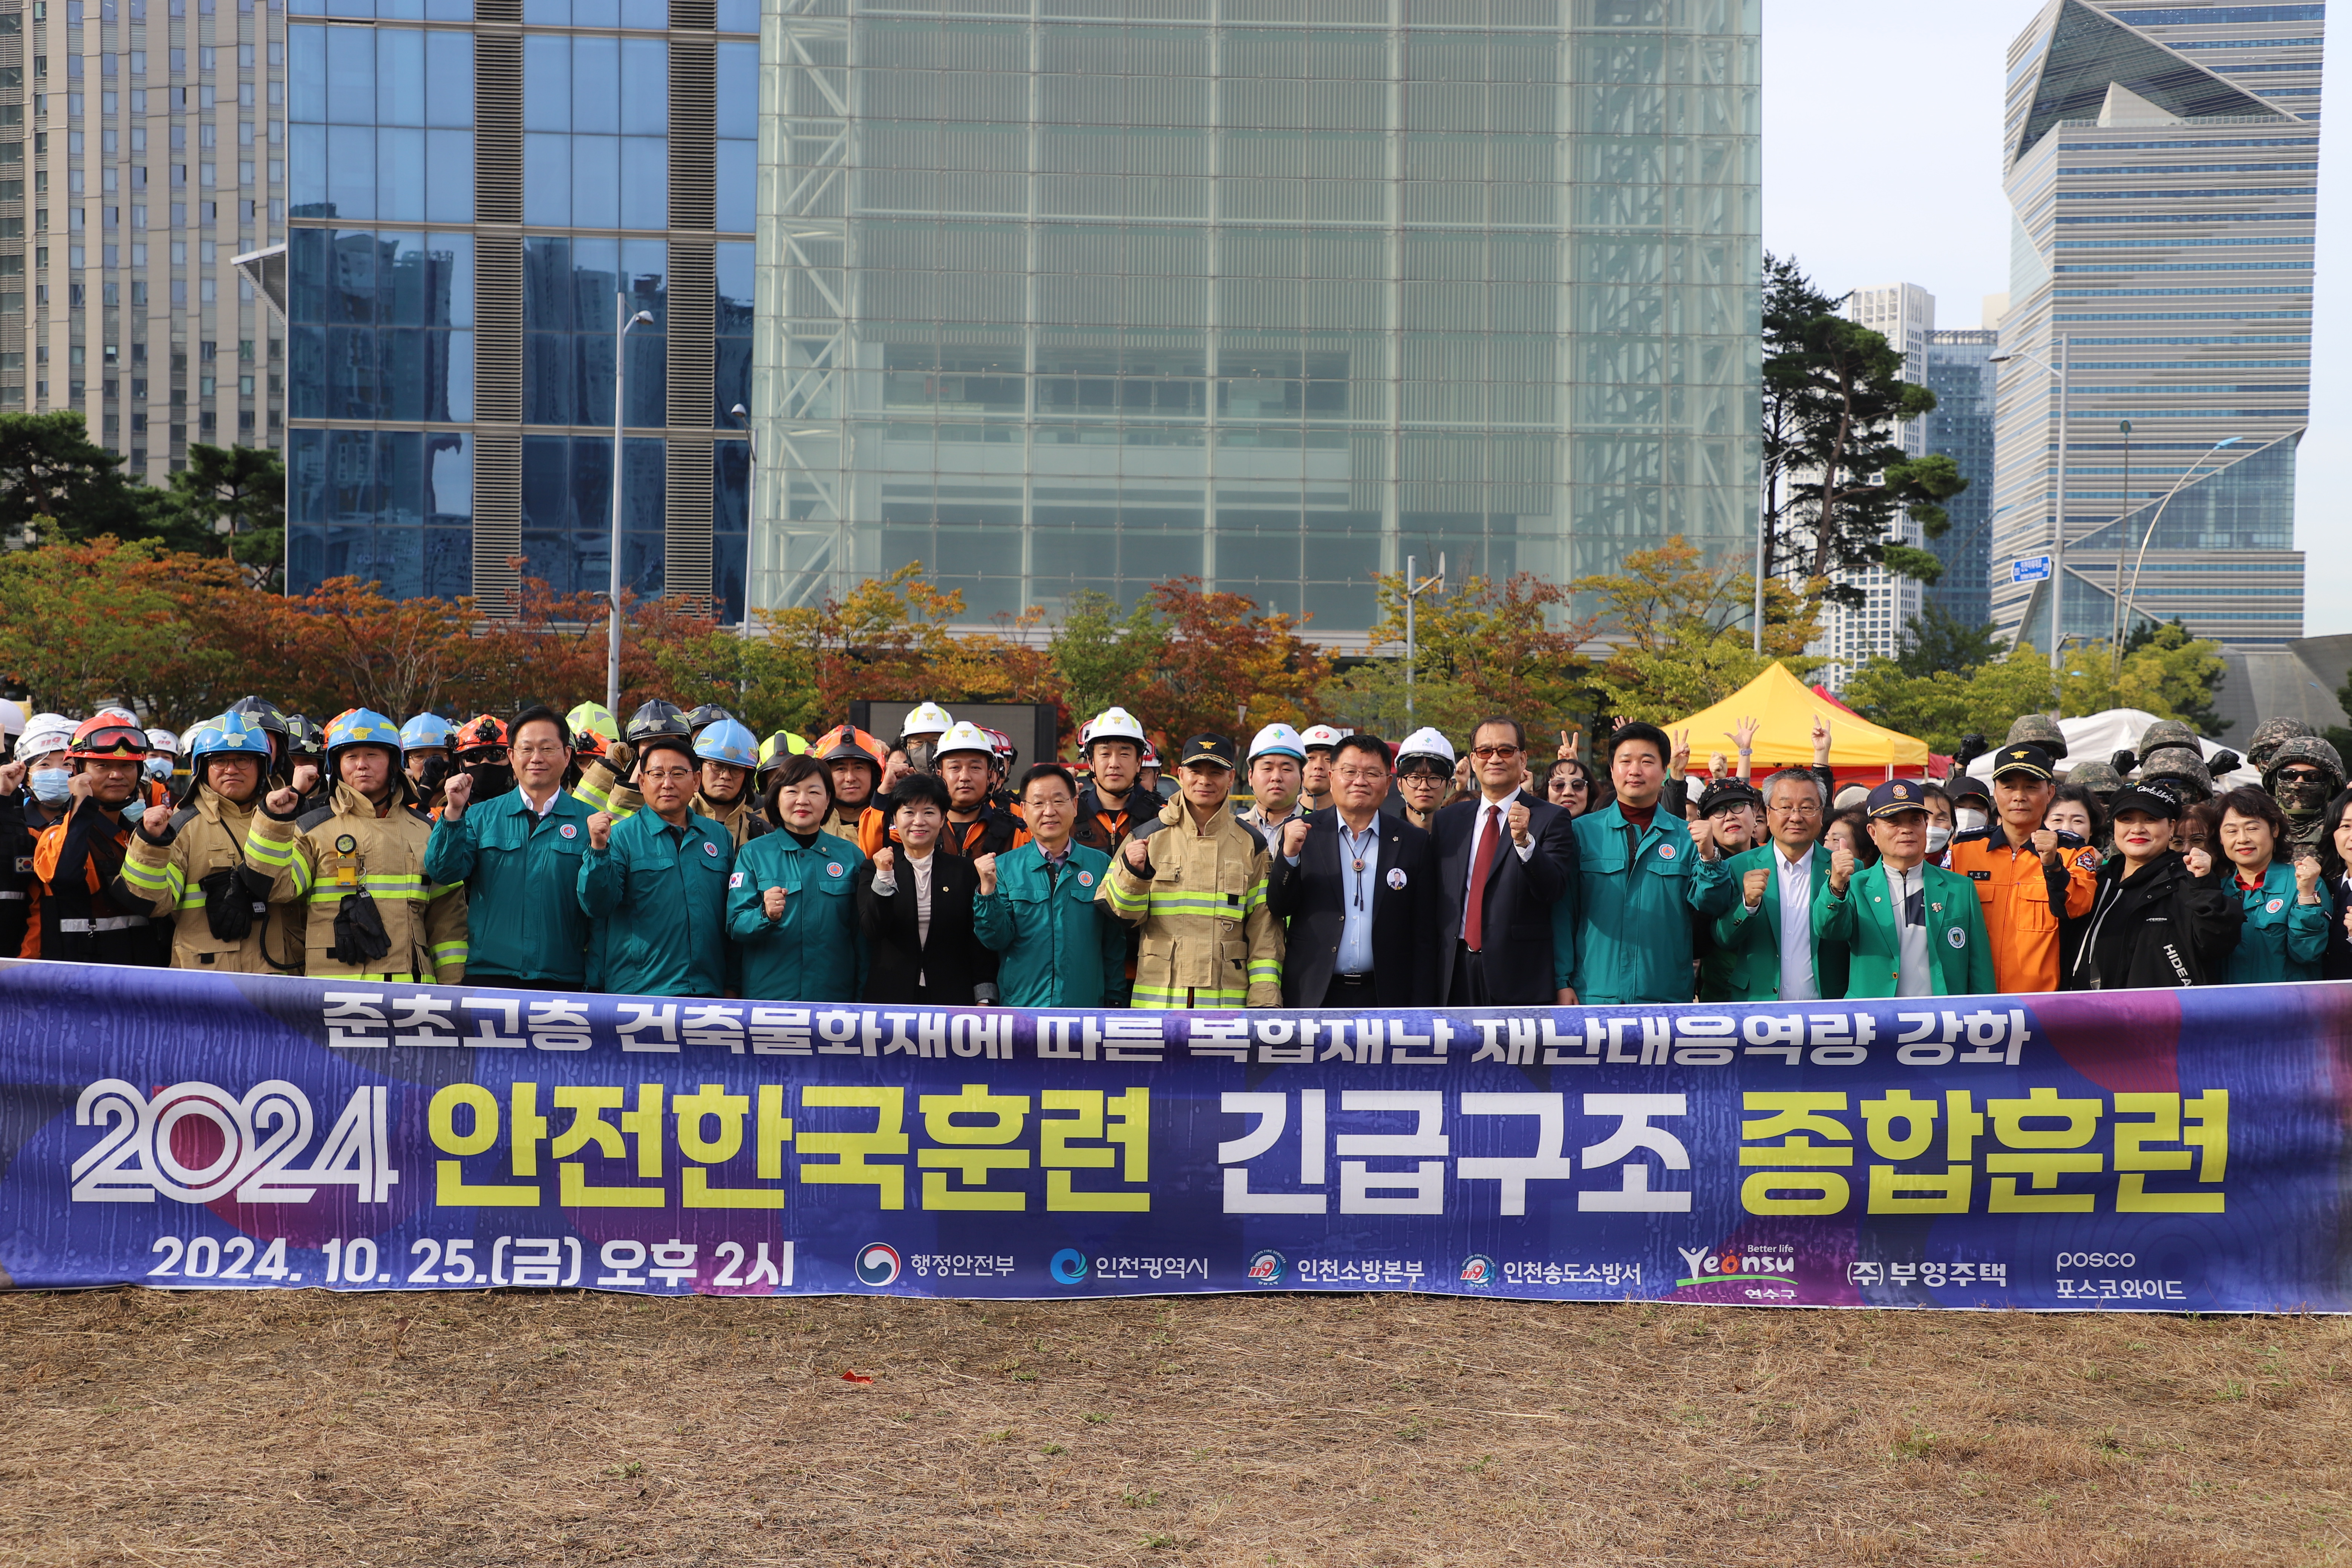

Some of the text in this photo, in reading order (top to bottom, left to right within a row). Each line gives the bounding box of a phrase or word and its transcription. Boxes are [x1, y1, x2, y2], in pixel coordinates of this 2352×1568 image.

[40, 737, 62, 747] 119
[323, 992, 2031, 1065] 준초고층 건축물화재에 따른 복합재난 재난대응역량 강화
[72, 1078, 2229, 1216] 2024 안전한국훈련 긴급구조 종합훈련
[1250, 1250, 1263, 1263] INCHEON
[1273, 1250, 1287, 1264] SERVICES
[1747, 1244, 1794, 1253] Better life
[147, 1236, 794, 1287] 2024. 10. 25.(금) 오후 2시
[911, 1254, 1015, 1277] 행정안전부
[1096, 1257, 1208, 1280] 인천광역시
[1248, 1260, 1275, 1277] 119
[1298, 1259, 1425, 1283] 인천소방본부
[1461, 1255, 1474, 1267] INCHEON
[1483, 1254, 1496, 1267] SERVICES
[1678, 1246, 1794, 1281] Yeonsu
[2056, 1252, 2136, 1272] posco
[1460, 1264, 1485, 1280] 119
[1504, 1262, 1641, 1286] 인천송도소방서
[1744, 1289, 1798, 1300] 연수구
[2056, 1279, 2187, 1300] 포스코와이드
